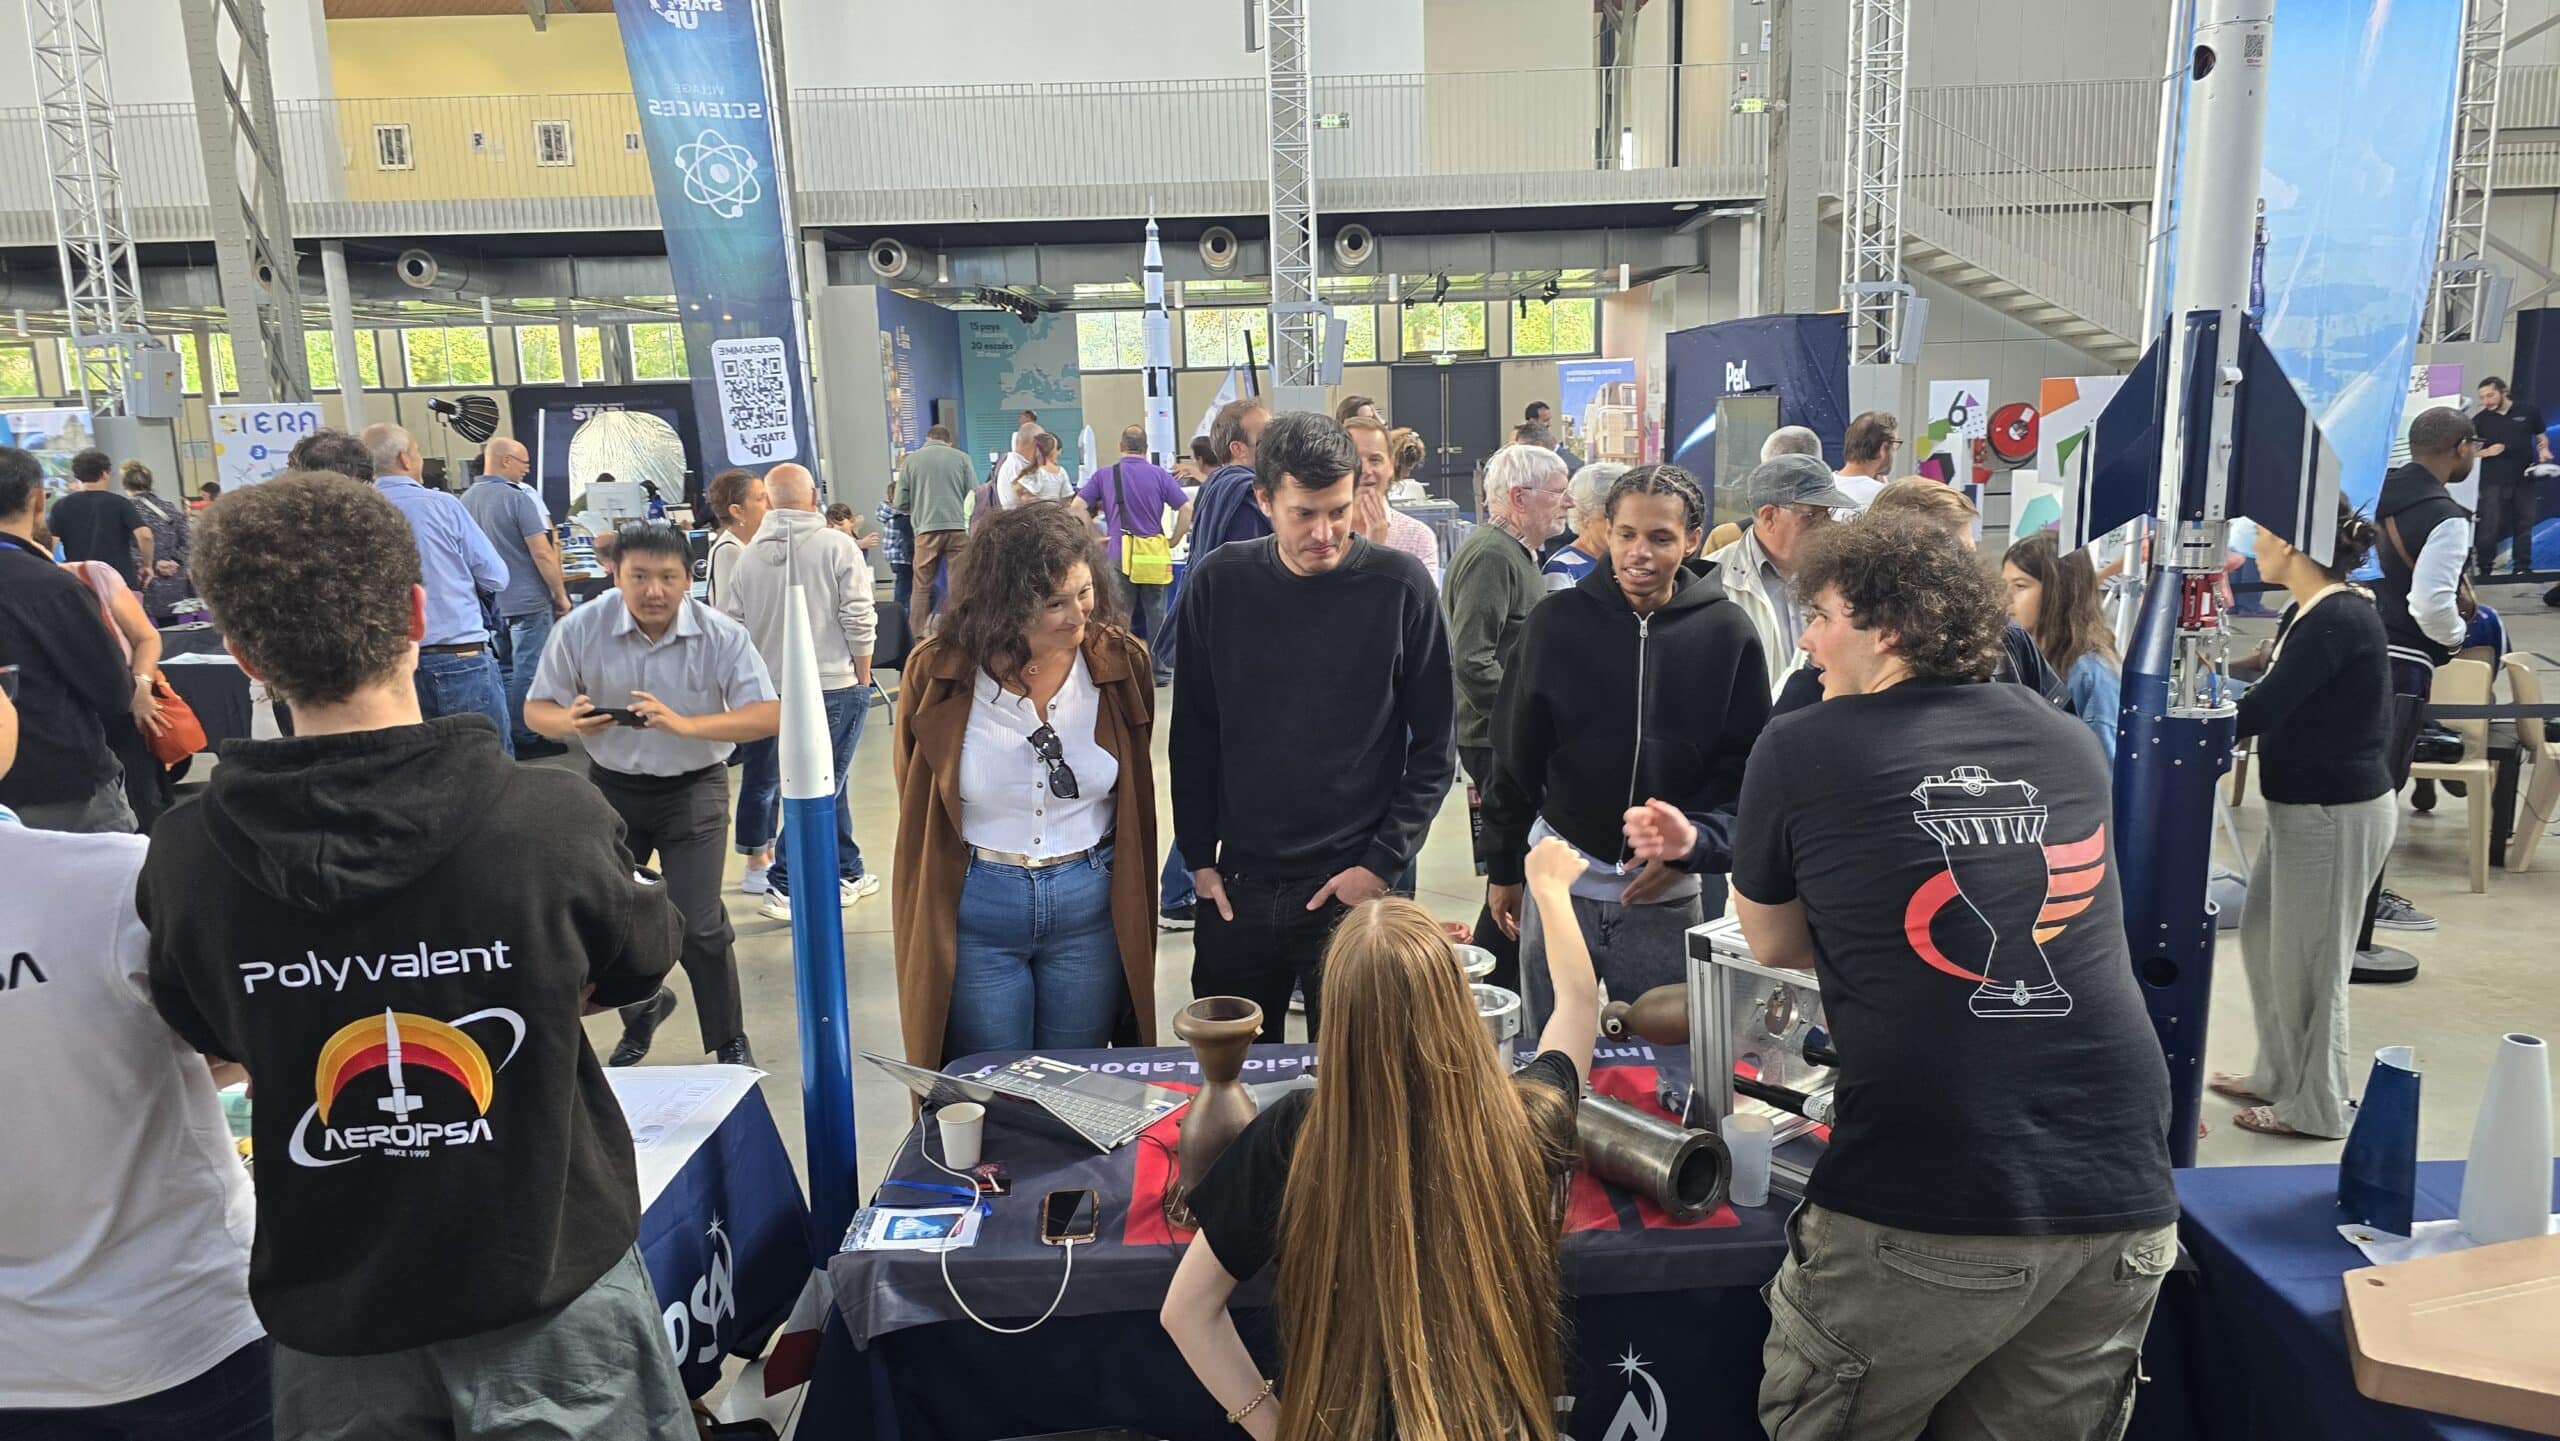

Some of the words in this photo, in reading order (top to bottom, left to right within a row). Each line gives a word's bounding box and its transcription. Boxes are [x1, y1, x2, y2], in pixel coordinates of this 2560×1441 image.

[219, 410, 317, 434] SIERA
[1948, 390, 1968, 427] 6
[239, 940, 513, 994] Polyvalent
[323, 1117, 493, 1151] AEROIPSA
[384, 1148, 406, 1157] SINCE
